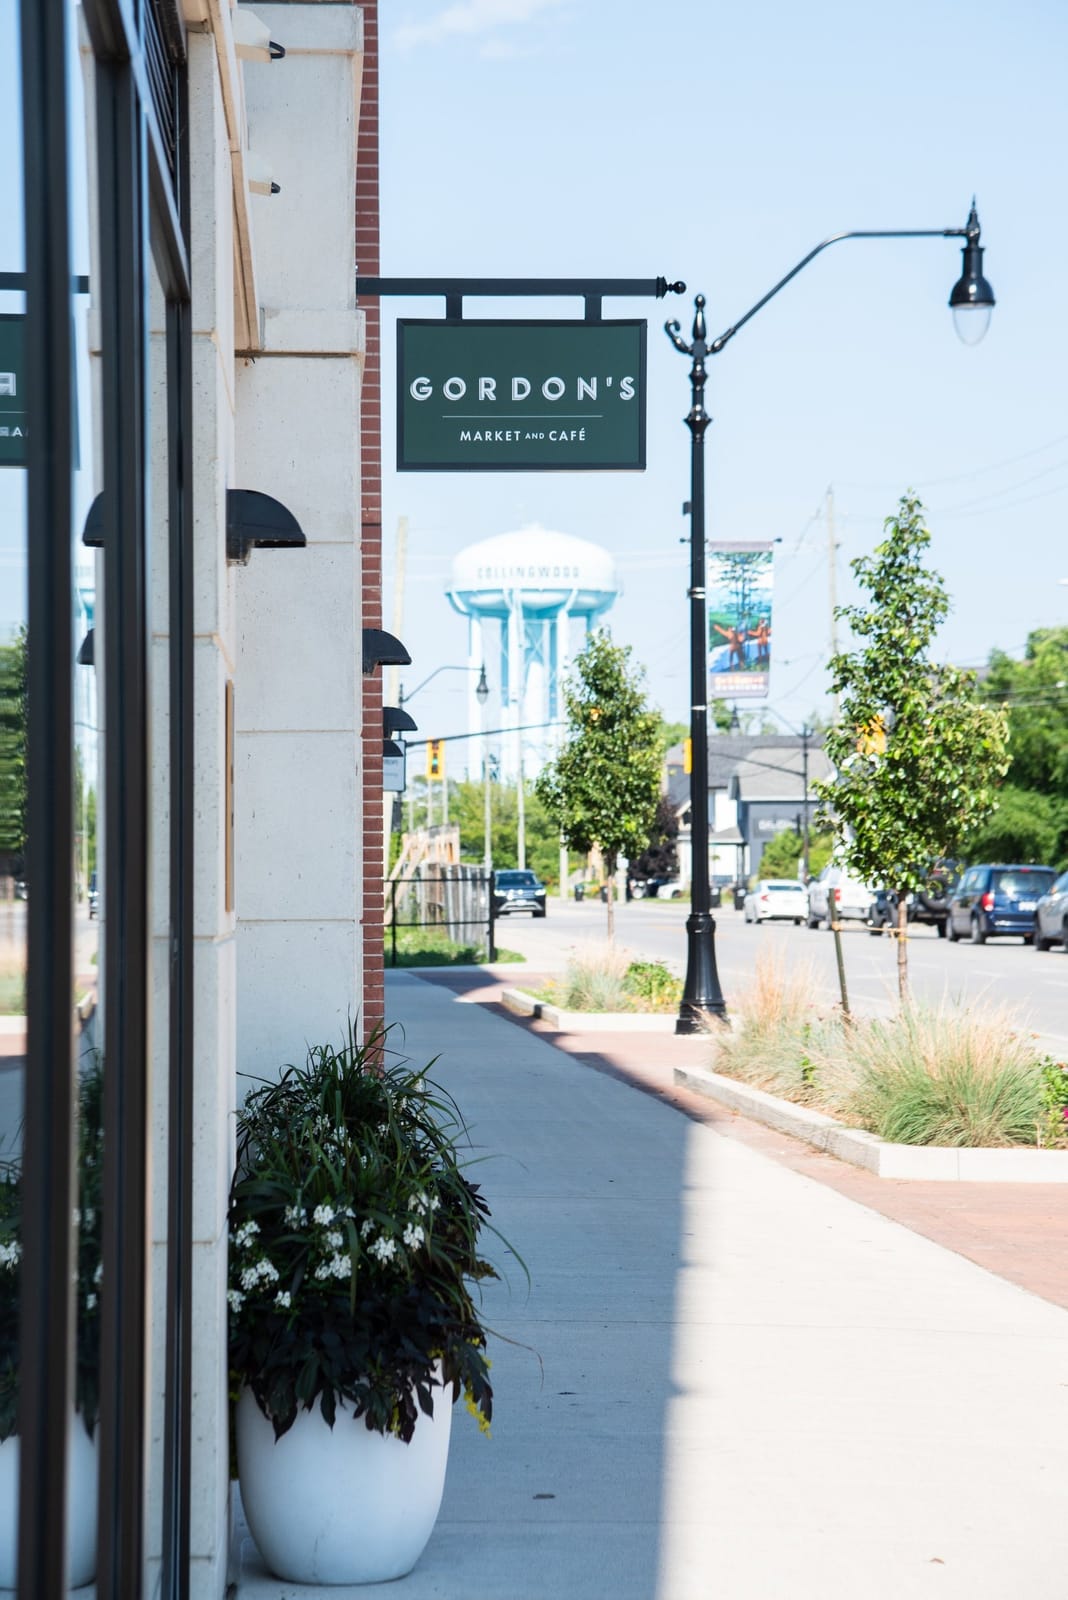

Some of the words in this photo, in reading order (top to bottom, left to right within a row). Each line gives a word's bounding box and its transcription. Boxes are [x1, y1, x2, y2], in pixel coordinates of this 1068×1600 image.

[410, 376, 636, 401] GORDON'S
[460, 430, 521, 441] MARKET
[525, 432, 545, 440] AND
[549, 427, 587, 441] CAFÉ
[477, 565, 580, 579] COLLINGWOOD
